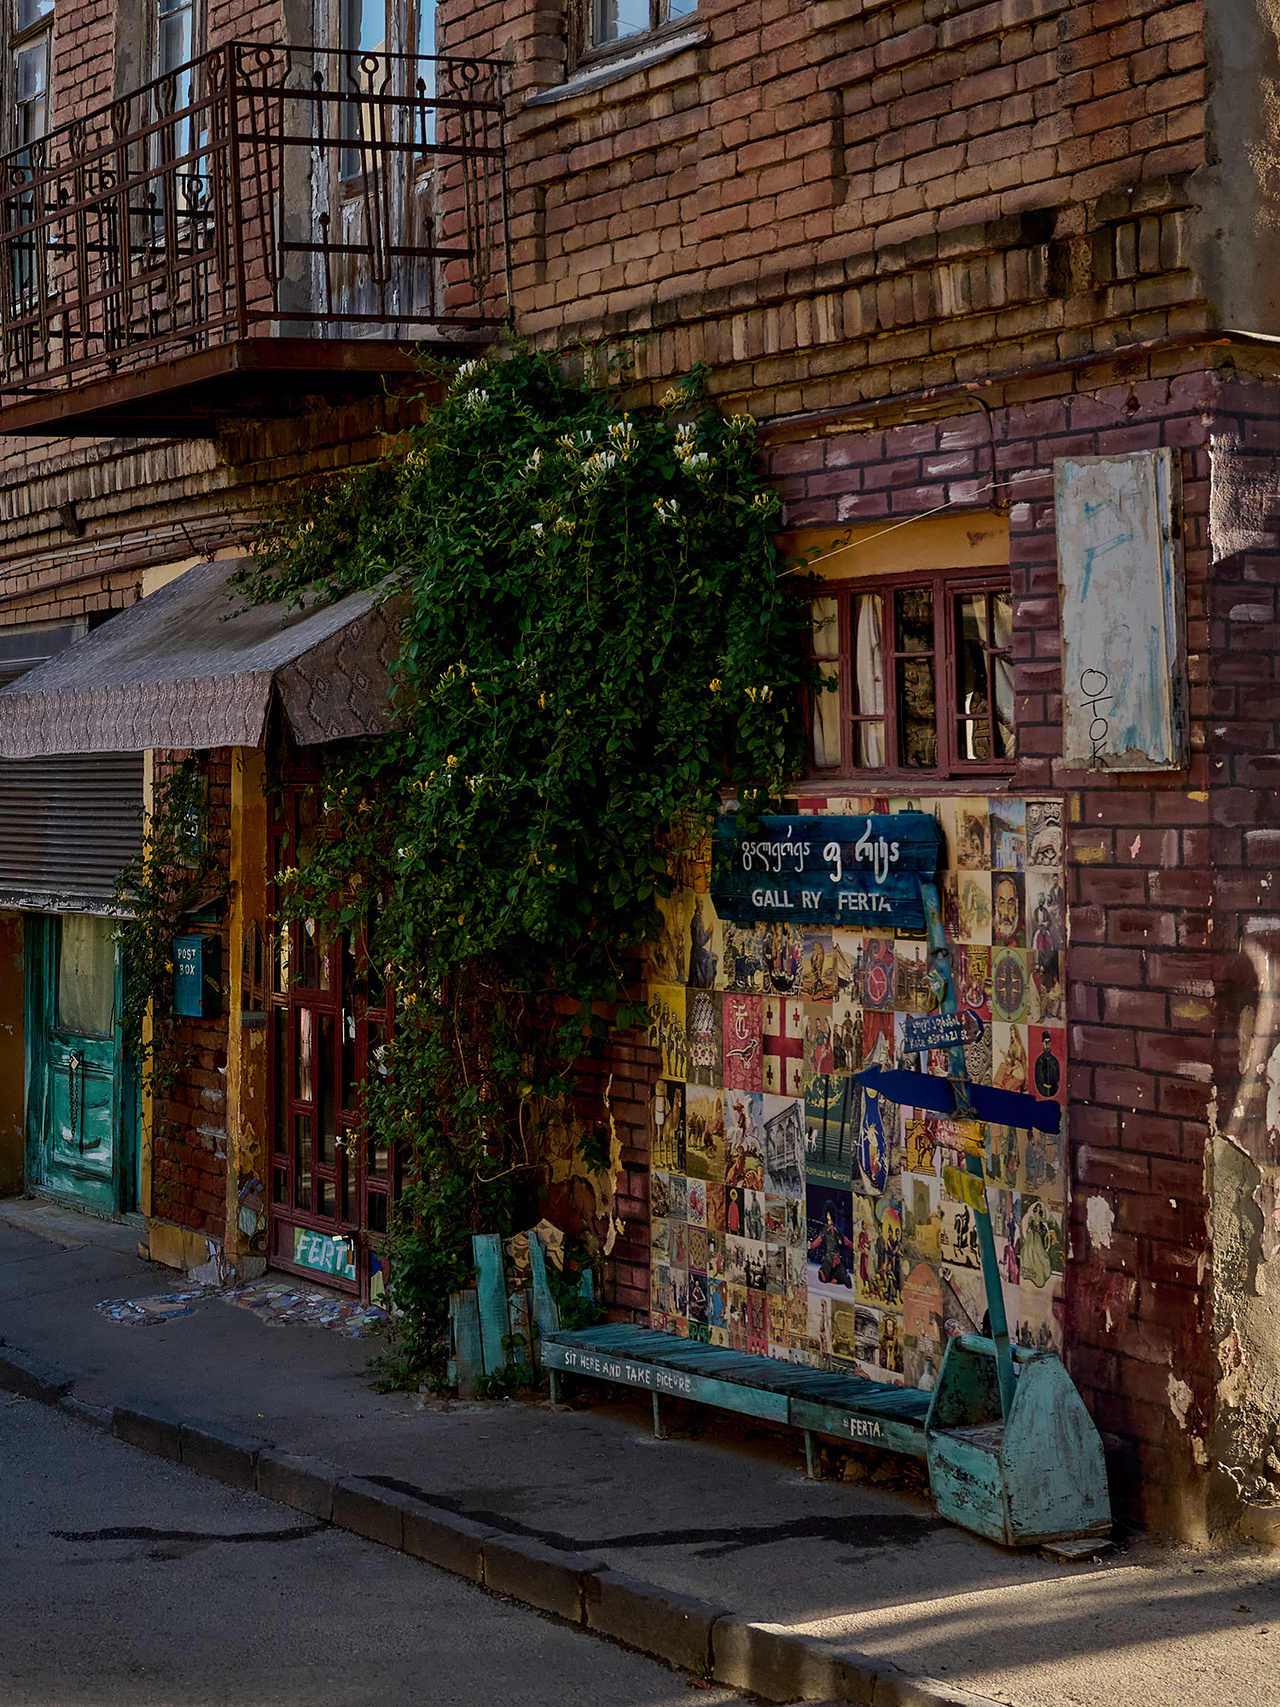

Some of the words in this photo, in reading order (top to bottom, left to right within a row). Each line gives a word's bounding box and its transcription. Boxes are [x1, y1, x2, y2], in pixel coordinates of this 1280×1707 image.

[837, 891, 893, 913] FERTA
[177, 948, 196, 960] POST
[179, 964, 196, 976] BOX
[580, 1355, 601, 1372] HERE
[602, 1362, 622, 1378] AND
[625, 1365, 651, 1385] TAKE
